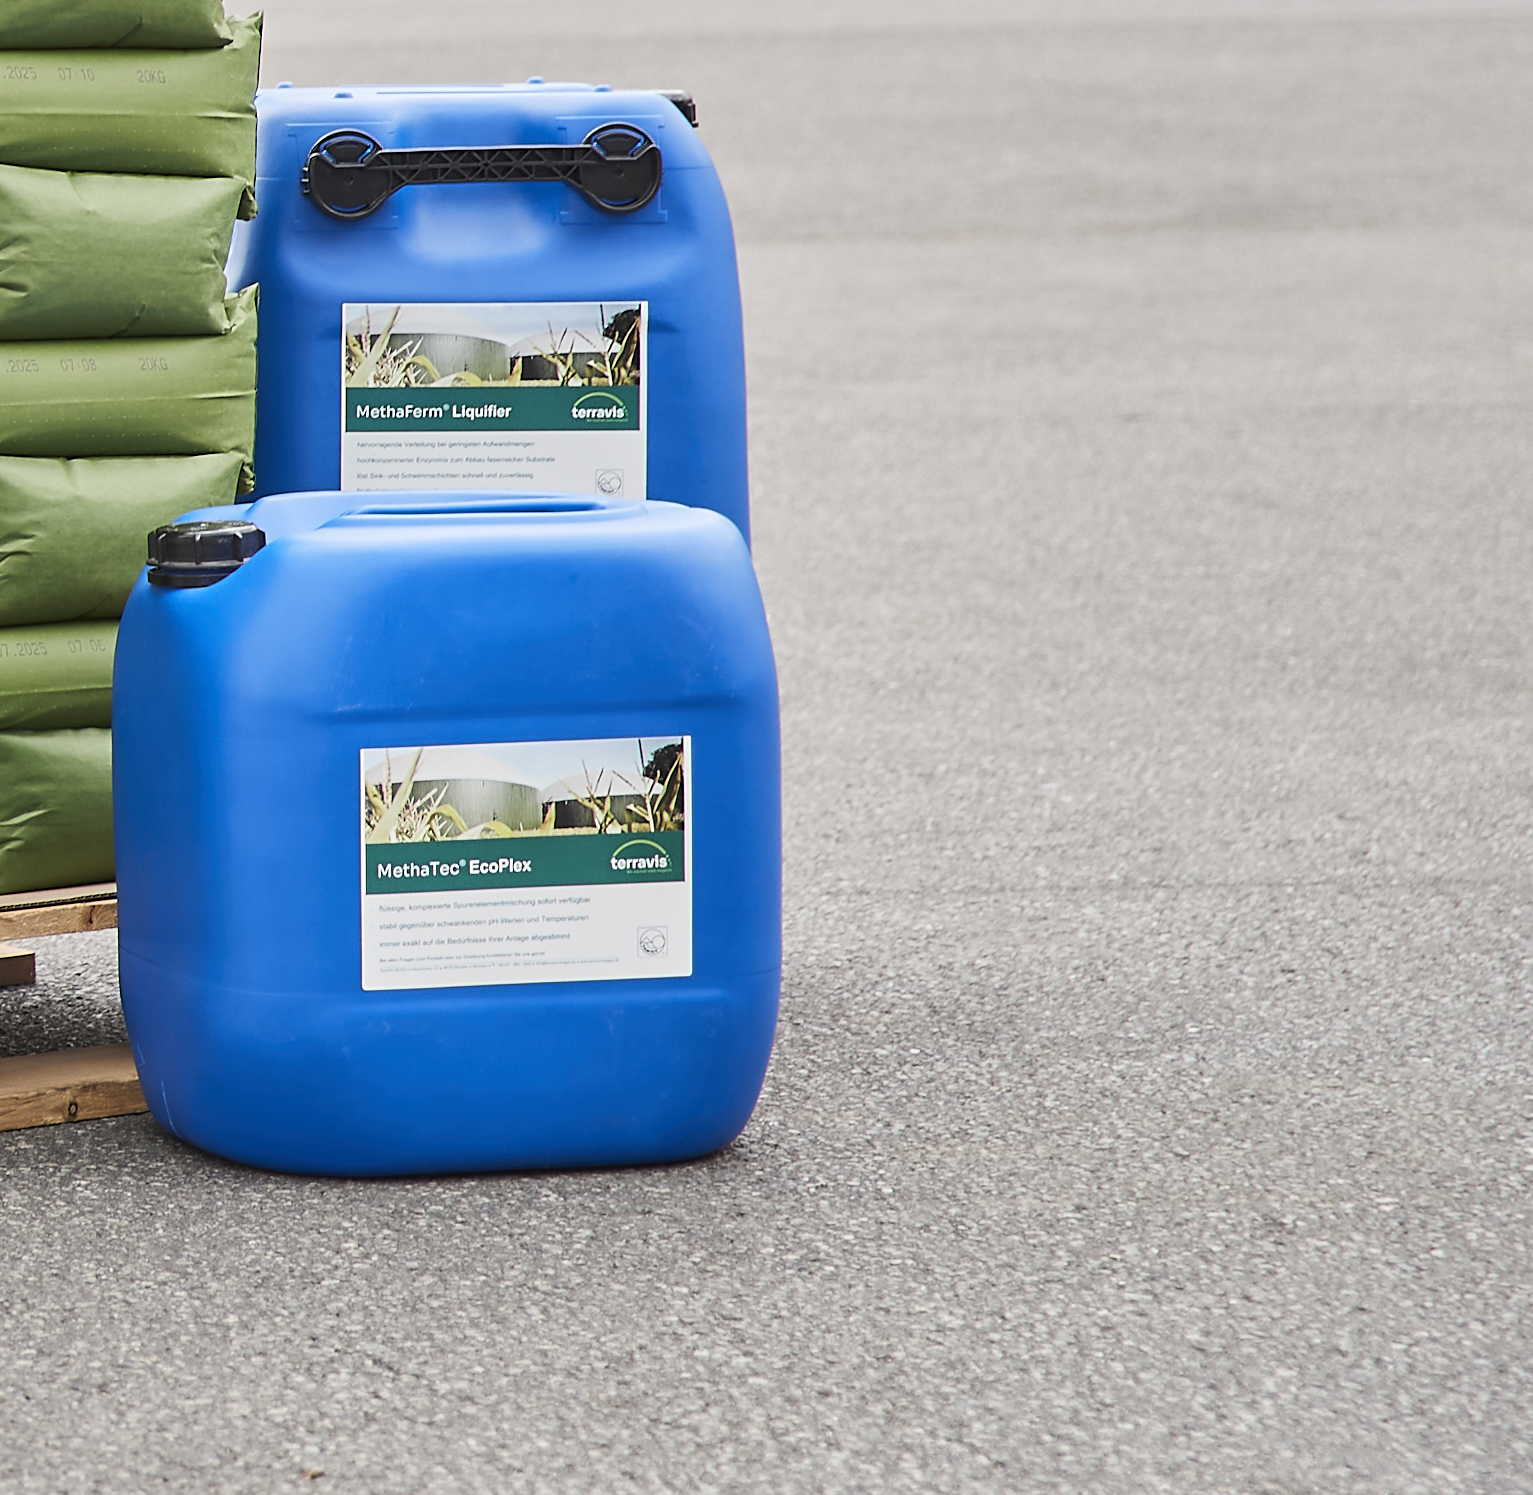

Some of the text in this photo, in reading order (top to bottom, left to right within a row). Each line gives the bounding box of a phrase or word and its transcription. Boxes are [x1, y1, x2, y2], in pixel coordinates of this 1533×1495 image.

[58, 66, 95, 82] 07:10
[137, 69, 167, 84] 20KG
[60, 357, 98, 372] 07:08
[140, 357, 169, 372] 20KG
[452, 404, 512, 421] Liquifier
[571, 405, 625, 419] terravis
[68, 638, 106, 654] 07:06
[469, 857, 532, 876] EcoPlex
[610, 854, 668, 870] terravis
[379, 922, 397, 930] stabil
[541, 914, 590, 923] Temperaturen
[402, 939, 421, 947] exakt
[505, 934, 530, 943] Anlage
